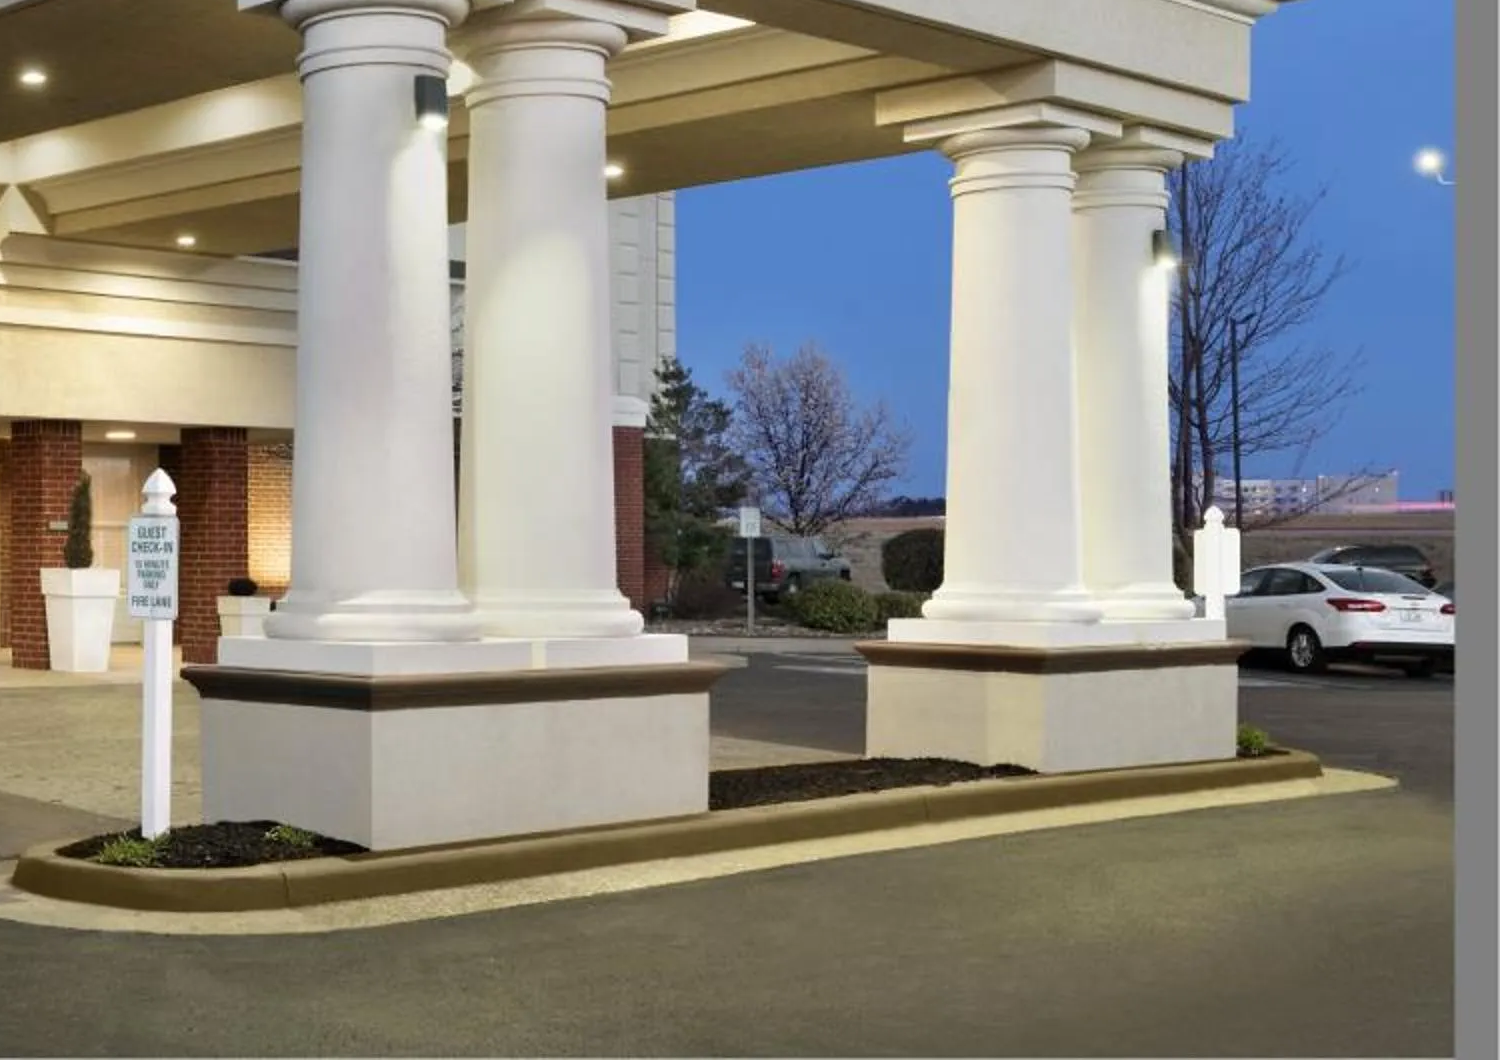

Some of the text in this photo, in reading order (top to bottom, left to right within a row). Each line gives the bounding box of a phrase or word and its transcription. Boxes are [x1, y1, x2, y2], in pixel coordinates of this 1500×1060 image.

[137, 525, 167, 539] GUEST
[131, 541, 173, 554] CHECK-IN
[131, 595, 172, 608] FIRE LANE
